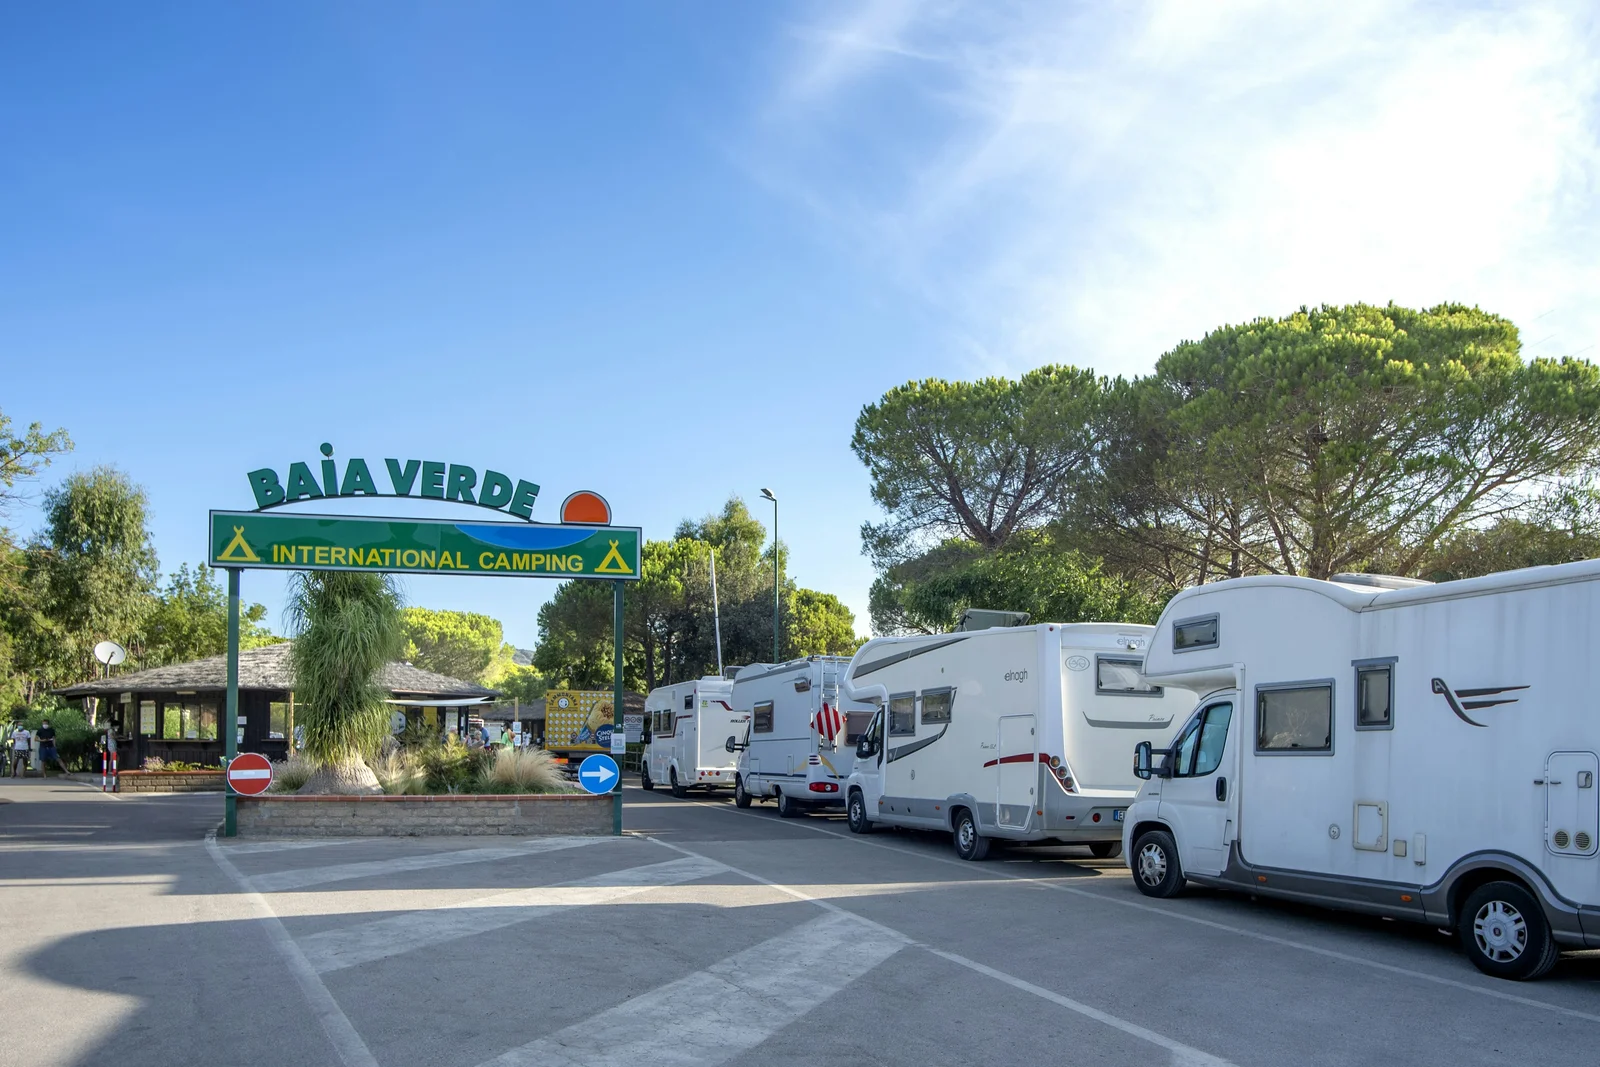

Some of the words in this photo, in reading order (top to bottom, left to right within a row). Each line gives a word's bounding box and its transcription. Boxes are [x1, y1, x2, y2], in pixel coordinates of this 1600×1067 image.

[384, 458, 541, 519] VERDE
[273, 544, 470, 568] INTERNATIONAL
[478, 551, 584, 572] CAMPING
